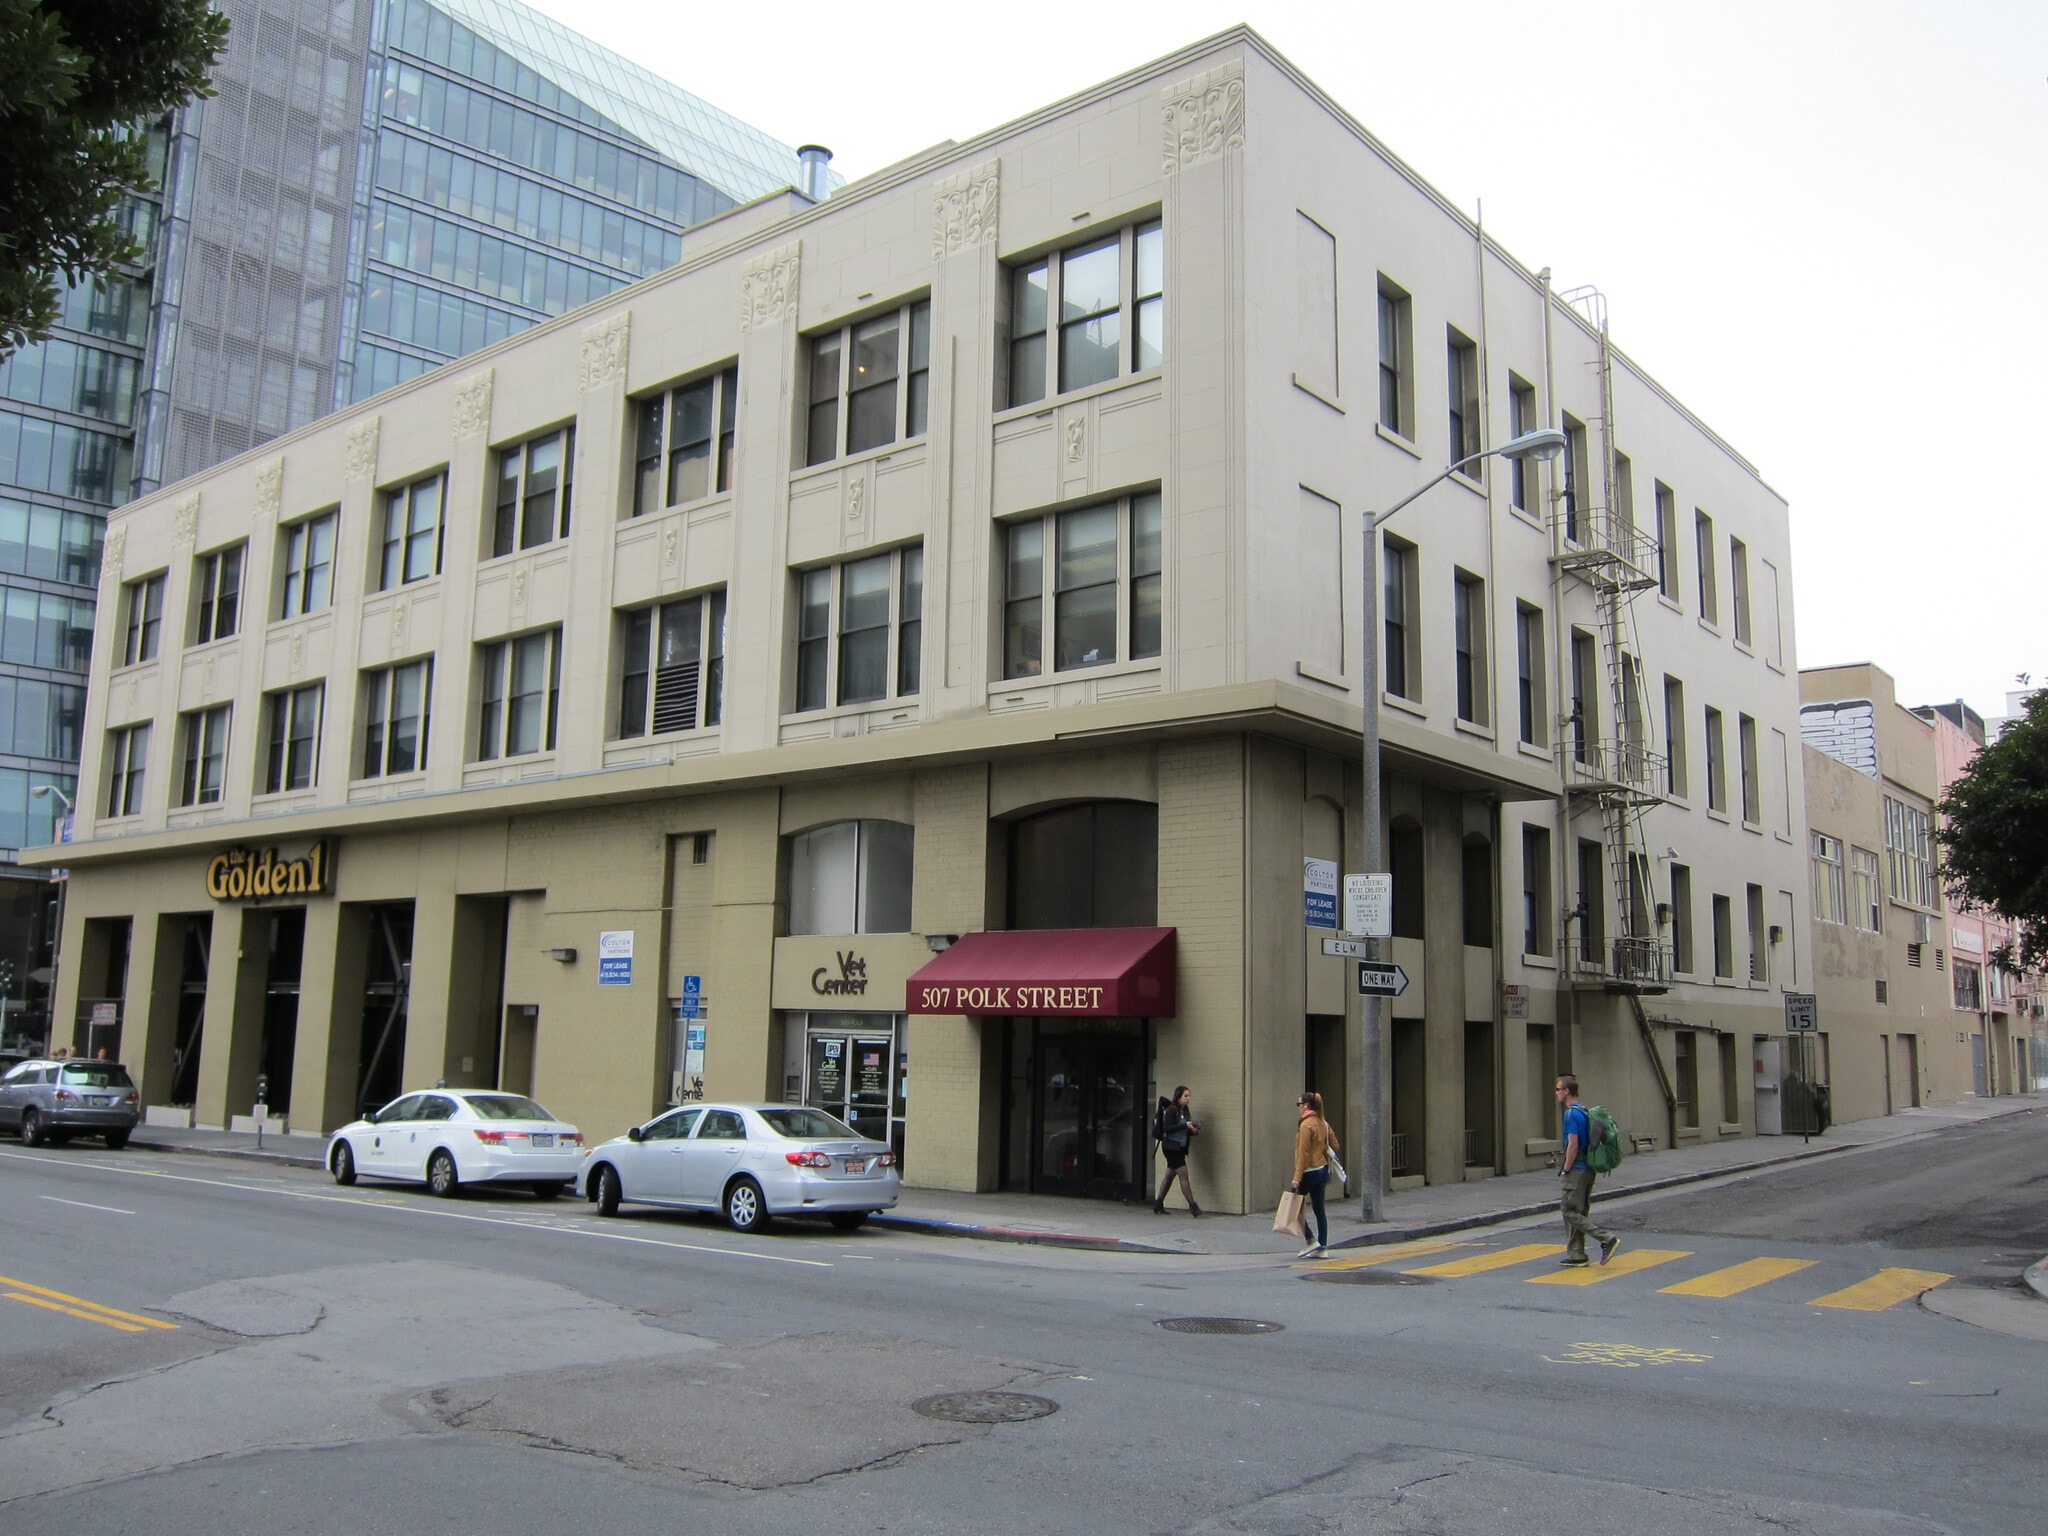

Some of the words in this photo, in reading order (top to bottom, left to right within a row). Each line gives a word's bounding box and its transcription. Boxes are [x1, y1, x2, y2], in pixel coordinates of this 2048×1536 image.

[230, 848, 246, 864] the
[1309, 869, 1334, 879] COLTON
[1310, 881, 1334, 890] PARTNERS
[1306, 898, 1317, 906] FOR
[1317, 900, 1333, 908] LEASE
[1334, 943, 1357, 954] ELM
[836, 951, 866, 980] Vet
[811, 967, 868, 995] Center
[1363, 972, 1378, 985] ONE
[1380, 974, 1396, 986] WAY
[921, 987, 950, 1008] 507
[955, 987, 1011, 1008] POLK
[1016, 987, 1103, 1008] STREET
[1791, 1015, 1811, 1029] 15
[691, 1076, 704, 1091] Ve
[675, 1085, 704, 1101] Cente
